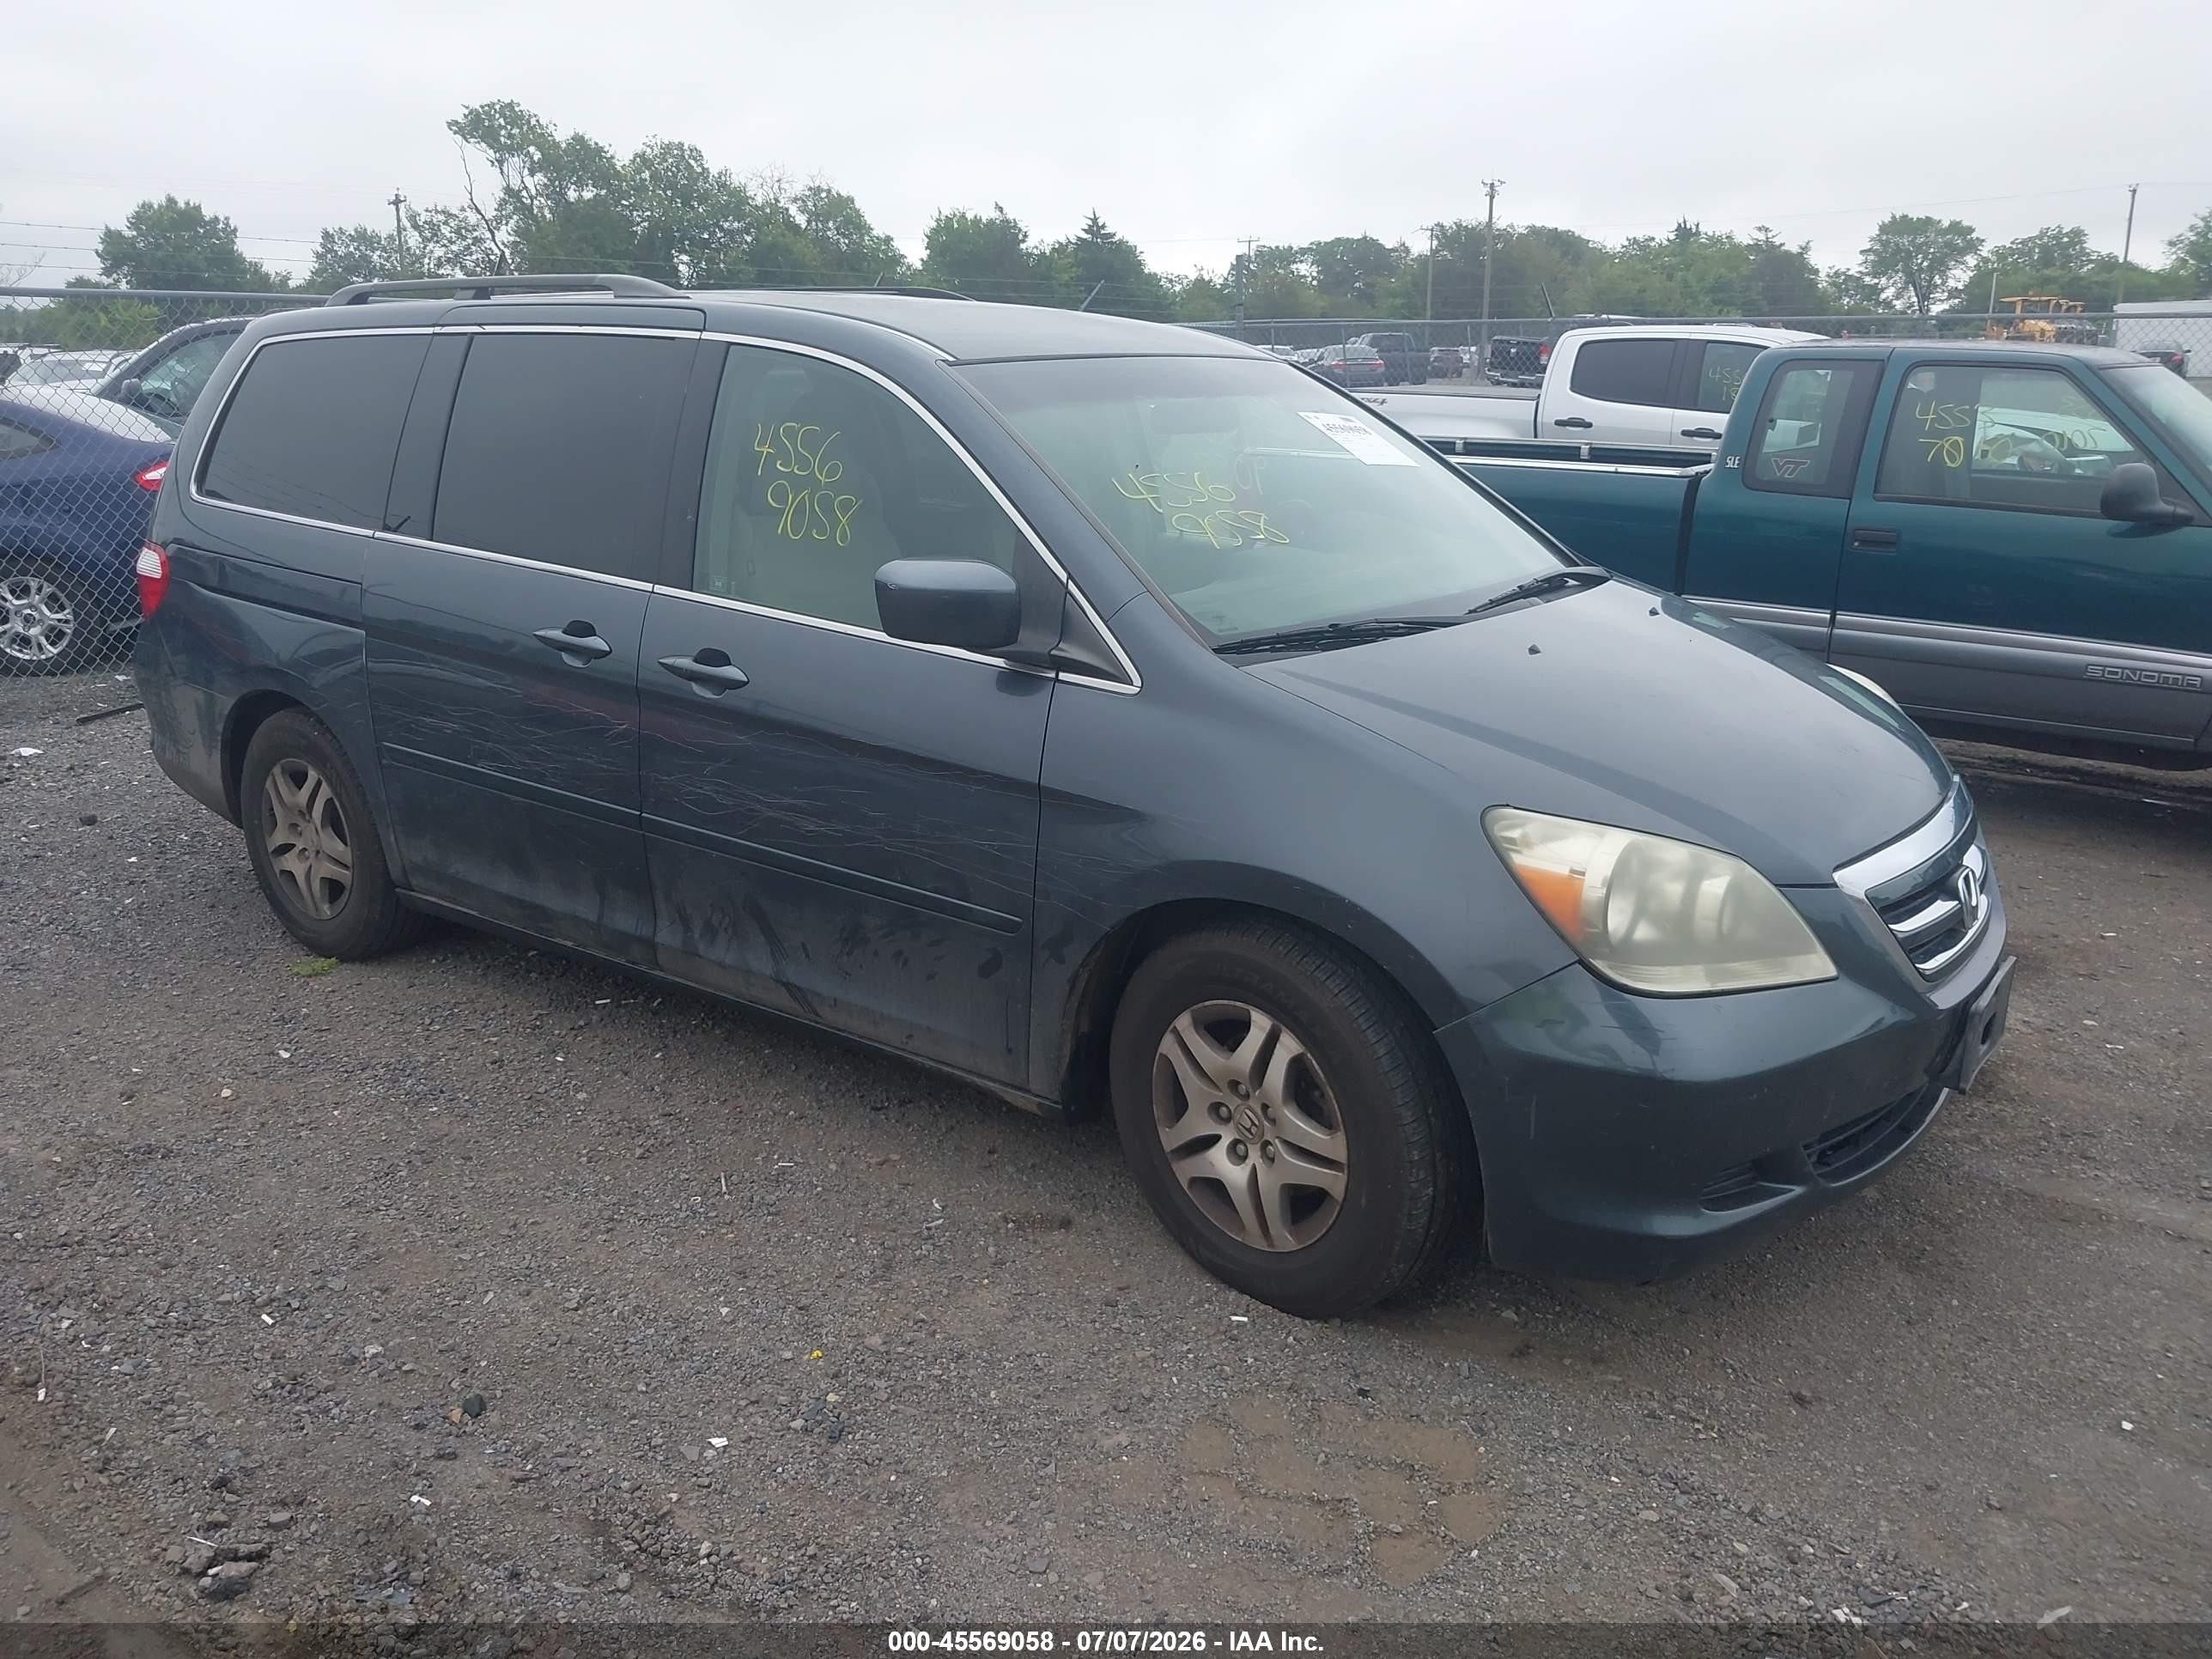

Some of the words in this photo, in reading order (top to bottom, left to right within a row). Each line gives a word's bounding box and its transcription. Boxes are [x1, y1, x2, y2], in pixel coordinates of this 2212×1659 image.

[754, 422, 844, 488] 4556
[1724, 456, 1741, 468] SLE
[1771, 458, 1811, 478] VT
[1111, 471, 1237, 513] 4556
[767, 480, 863, 546] 9058
[2086, 665, 2203, 688] SONOMA
